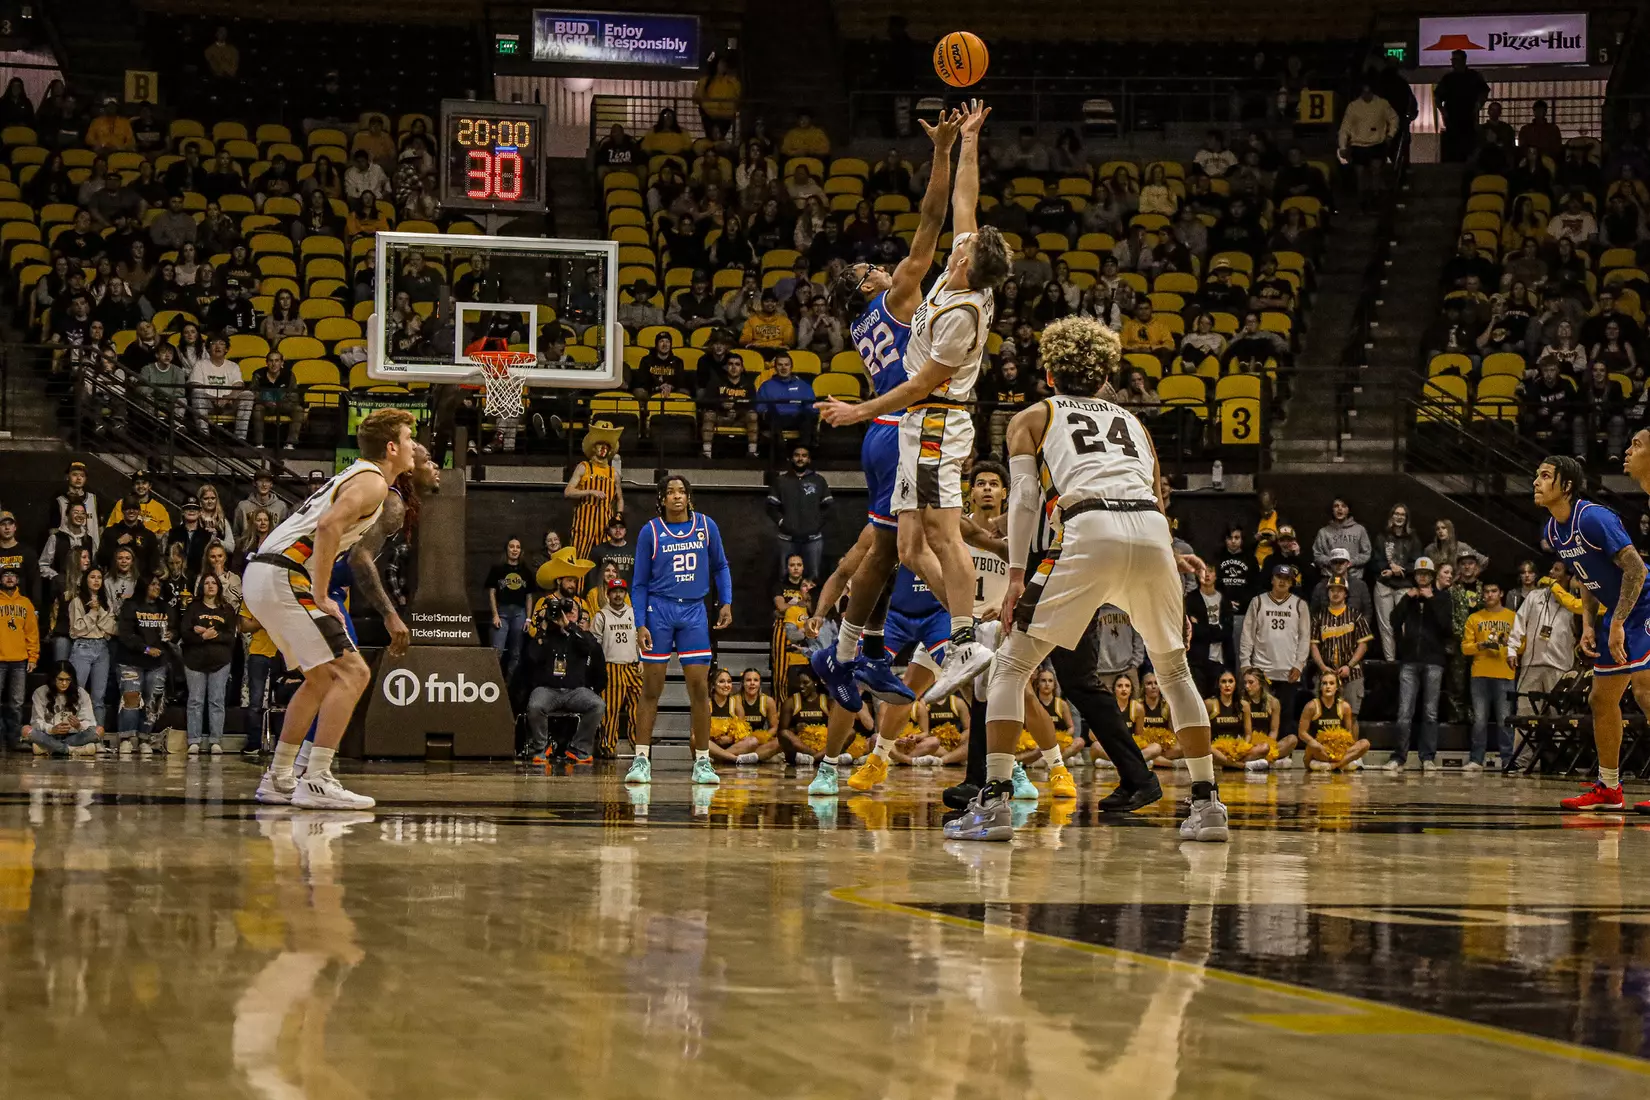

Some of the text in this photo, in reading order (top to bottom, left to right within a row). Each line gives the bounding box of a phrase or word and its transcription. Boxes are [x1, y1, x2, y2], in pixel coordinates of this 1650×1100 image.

[554, 21, 590, 35] BUD
[604, 24, 644, 46] Enjoy
[604, 41, 688, 60] Responsibly
[951, 43, 967, 70] NCAA
[1598, 48, 1609, 64] 5
[937, 43, 951, 79] Wilson
[133, 73, 151, 101] B
[1309, 94, 1325, 120] B
[457, 118, 532, 149] 20:00
[466, 149, 525, 201] 30
[915, 301, 928, 337] BOYS
[857, 321, 901, 377] 22
[1055, 400, 1132, 420] MALDON
[1232, 407, 1251, 439] 3
[1066, 412, 1141, 458] 24
[662, 541, 704, 553] LOUISIANA
[672, 552, 698, 573] 20
[973, 557, 1006, 576] BOYS
[1572, 560, 1589, 581] 0
[675, 573, 696, 583] TECH
[912, 585, 931, 593] TEC
[0, 604, 27, 620] YOMING
[411, 612, 474, 623] TicketSmarter
[1102, 613, 1130, 626] YOMIN
[1265, 610, 1292, 618] WYOMING
[411, 628, 473, 639] TicketSmarter
[1271, 618, 1286, 631] 33
[1478, 620, 1511, 634] WYOMING
[615, 633, 629, 644] 33
[425, 672, 501, 703] fnbo
